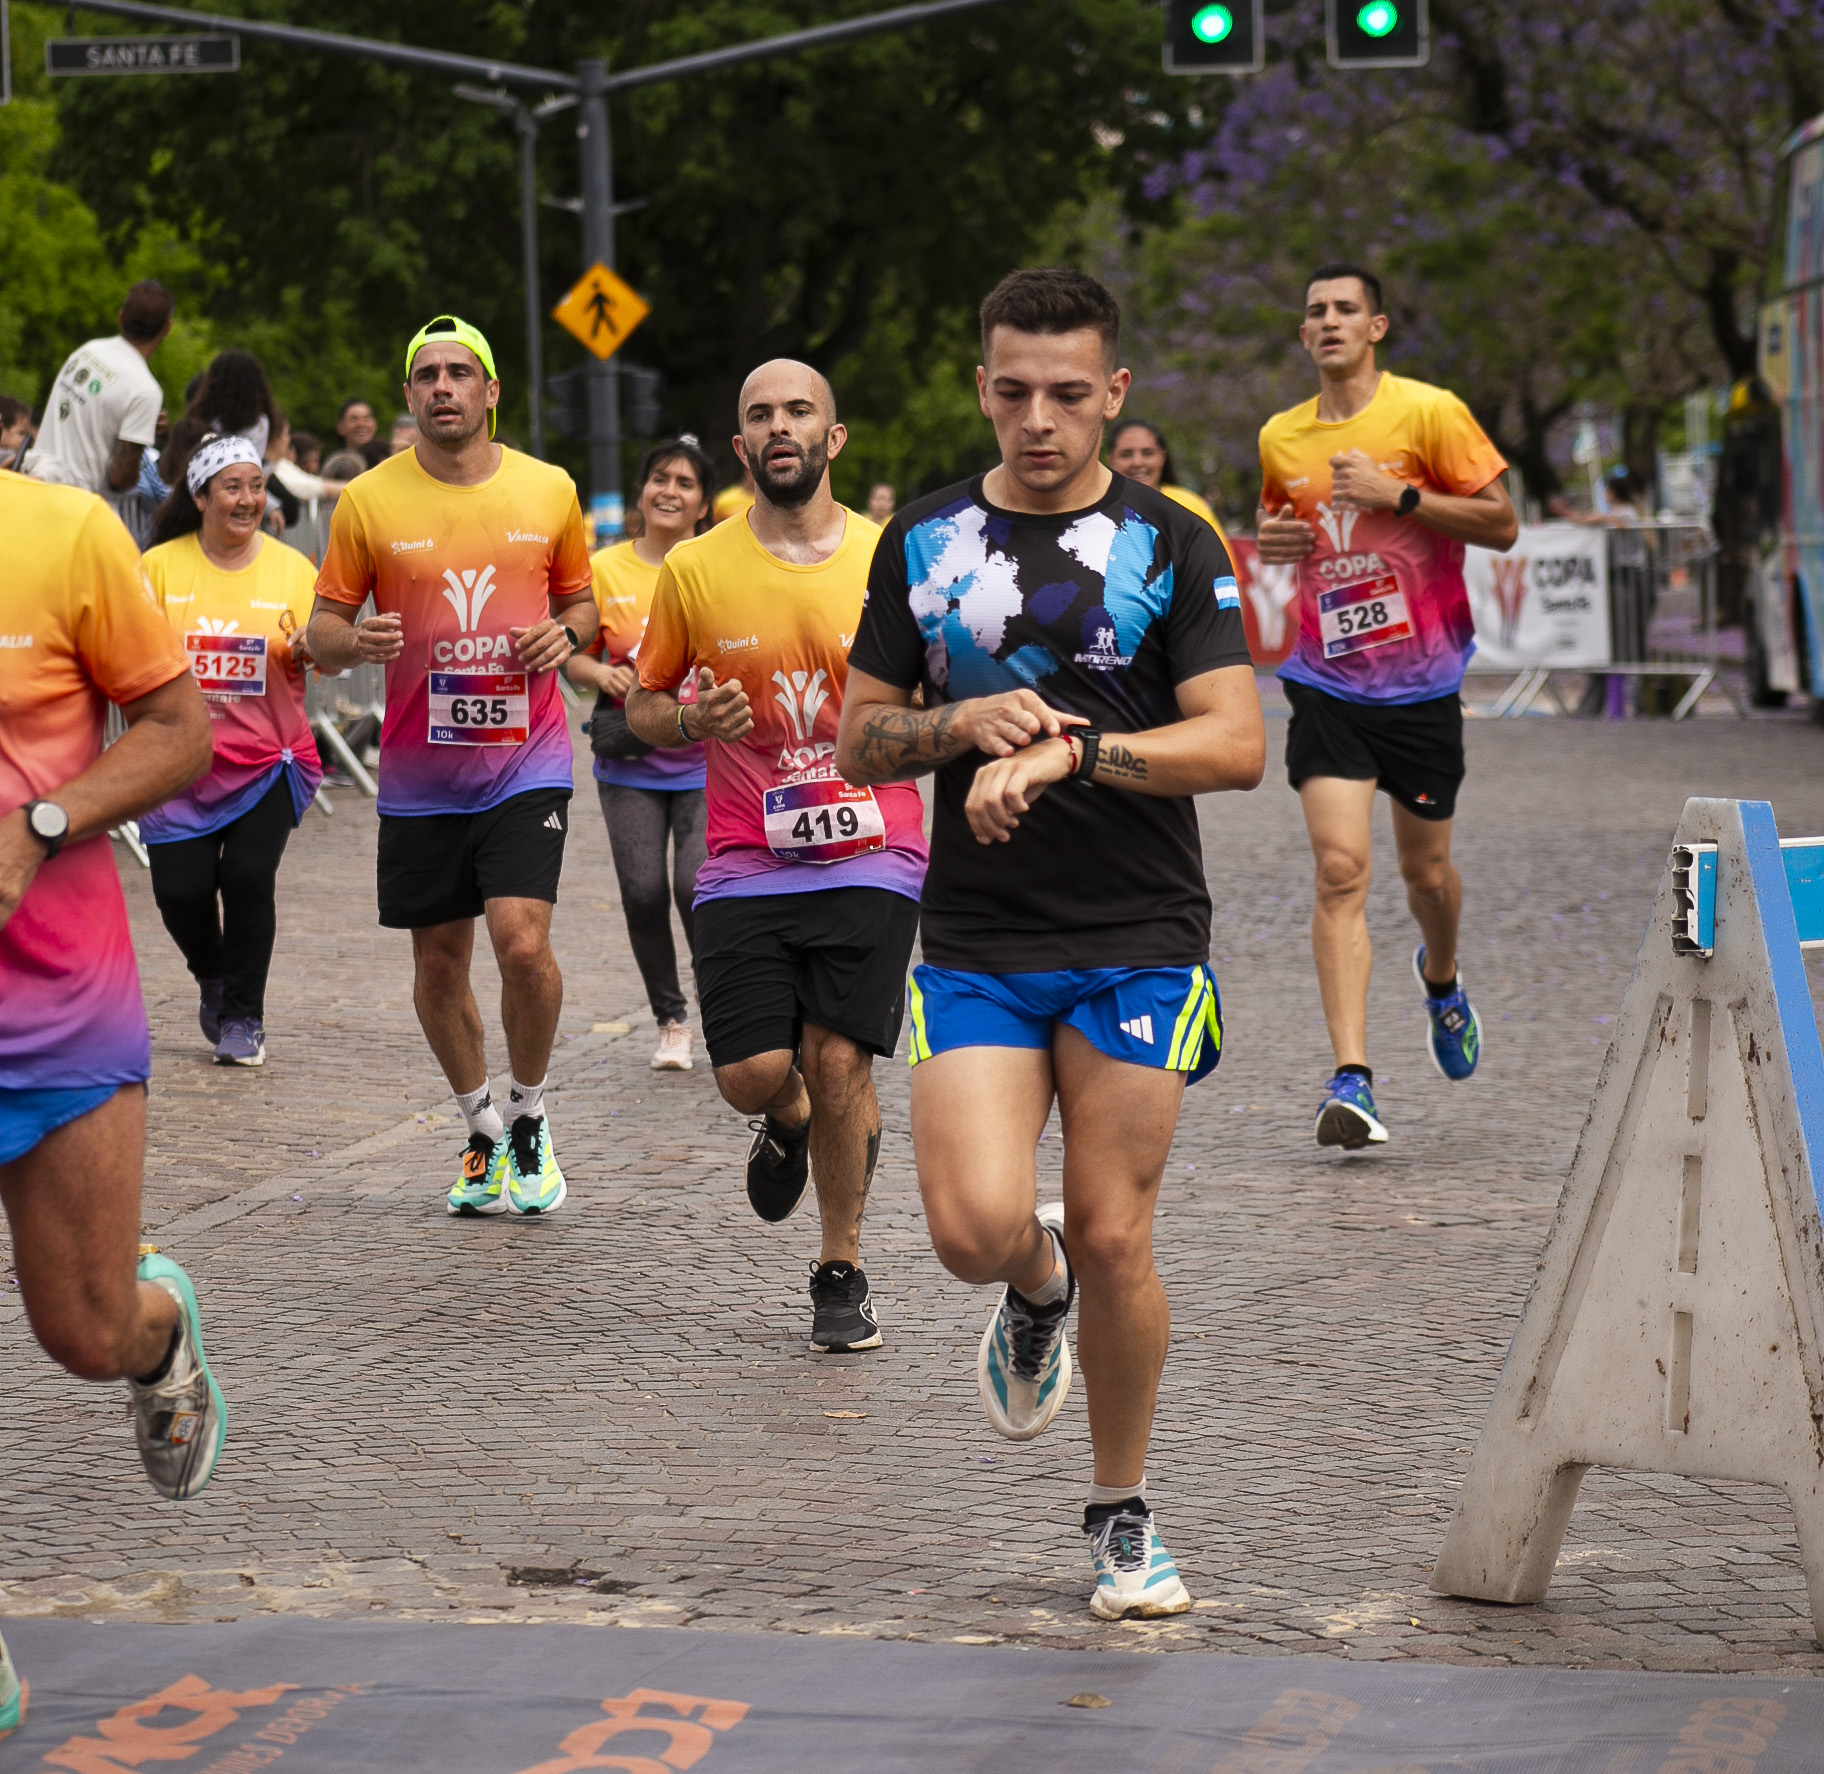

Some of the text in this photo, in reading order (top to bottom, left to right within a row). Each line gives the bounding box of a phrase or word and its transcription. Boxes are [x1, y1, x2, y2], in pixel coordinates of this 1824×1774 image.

[86, 44, 199, 68] SANTA FE
[426, 538, 434, 548] 6
[1320, 551, 1385, 580] COPA
[1533, 556, 1596, 588] COPA
[1337, 601, 1388, 634] 528
[433, 635, 512, 663] COPA
[750, 635, 758, 646] 6
[194, 655, 256, 679] 5125
[1074, 653, 1132, 666] MORENO
[450, 698, 508, 726] 635
[436, 729, 454, 740] 10k
[778, 742, 837, 771] COP
[838, 790, 857, 798] Santa
[791, 806, 859, 842] 419
